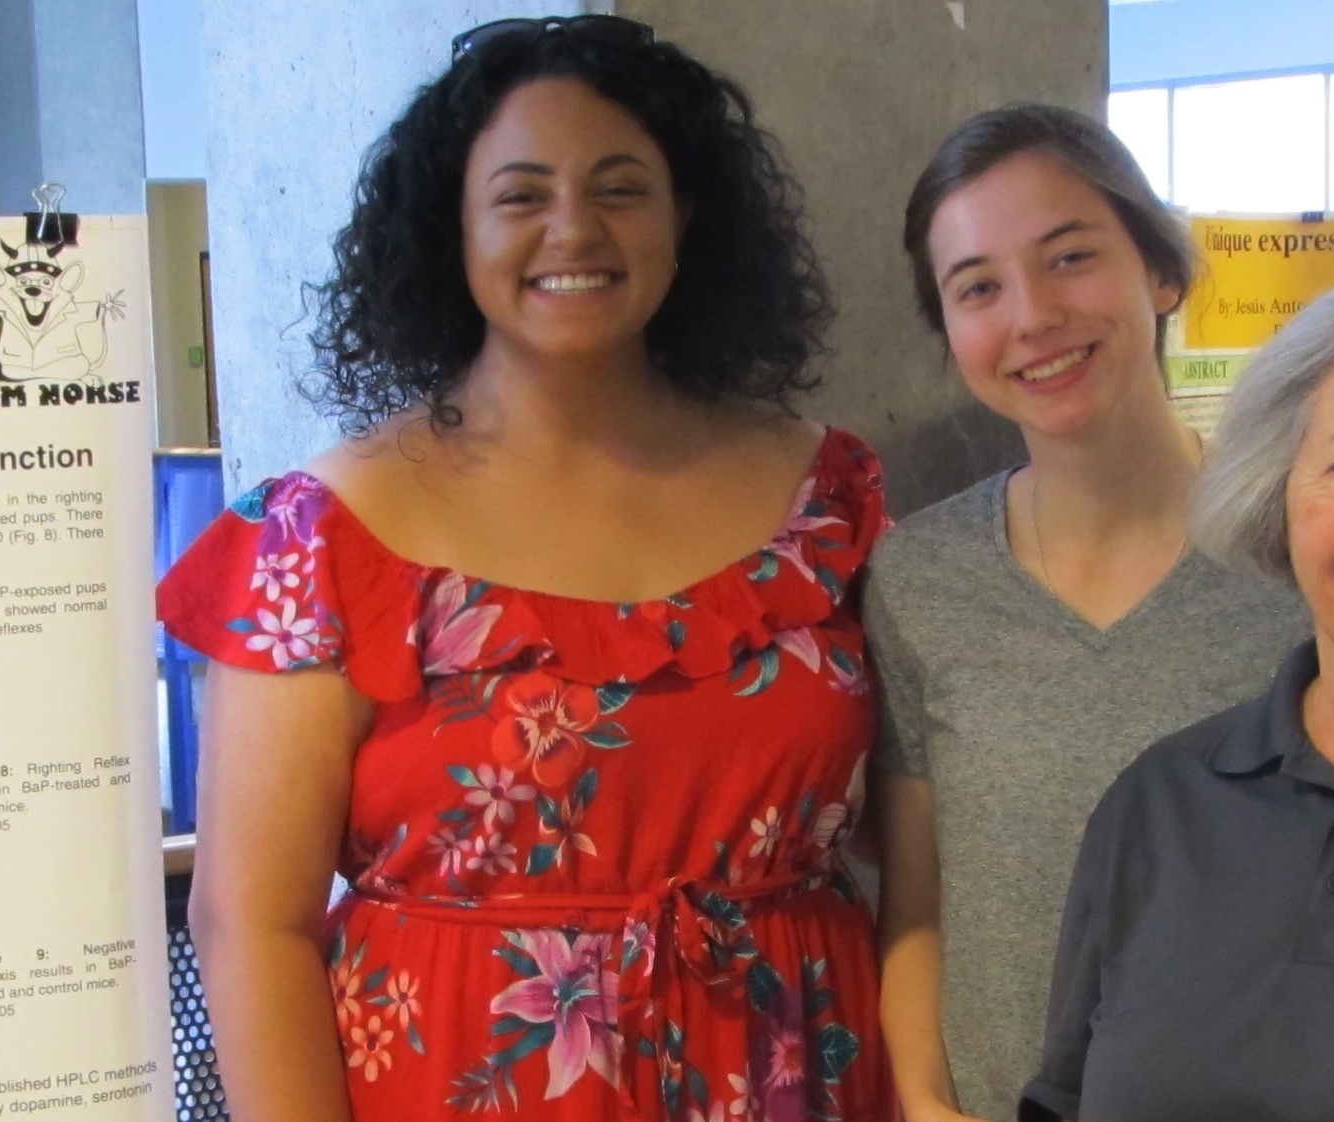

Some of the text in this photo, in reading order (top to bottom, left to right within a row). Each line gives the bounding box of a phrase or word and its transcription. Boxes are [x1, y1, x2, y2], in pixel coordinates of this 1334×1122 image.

[75, 582, 107, 596] pups
[0, 764, 14, 777] 8:
[27, 762, 81, 777] Righting
[94, 755, 130, 769] Reflex
[36, 948, 48, 961] 9:
[83, 939, 135, 956] Negative
